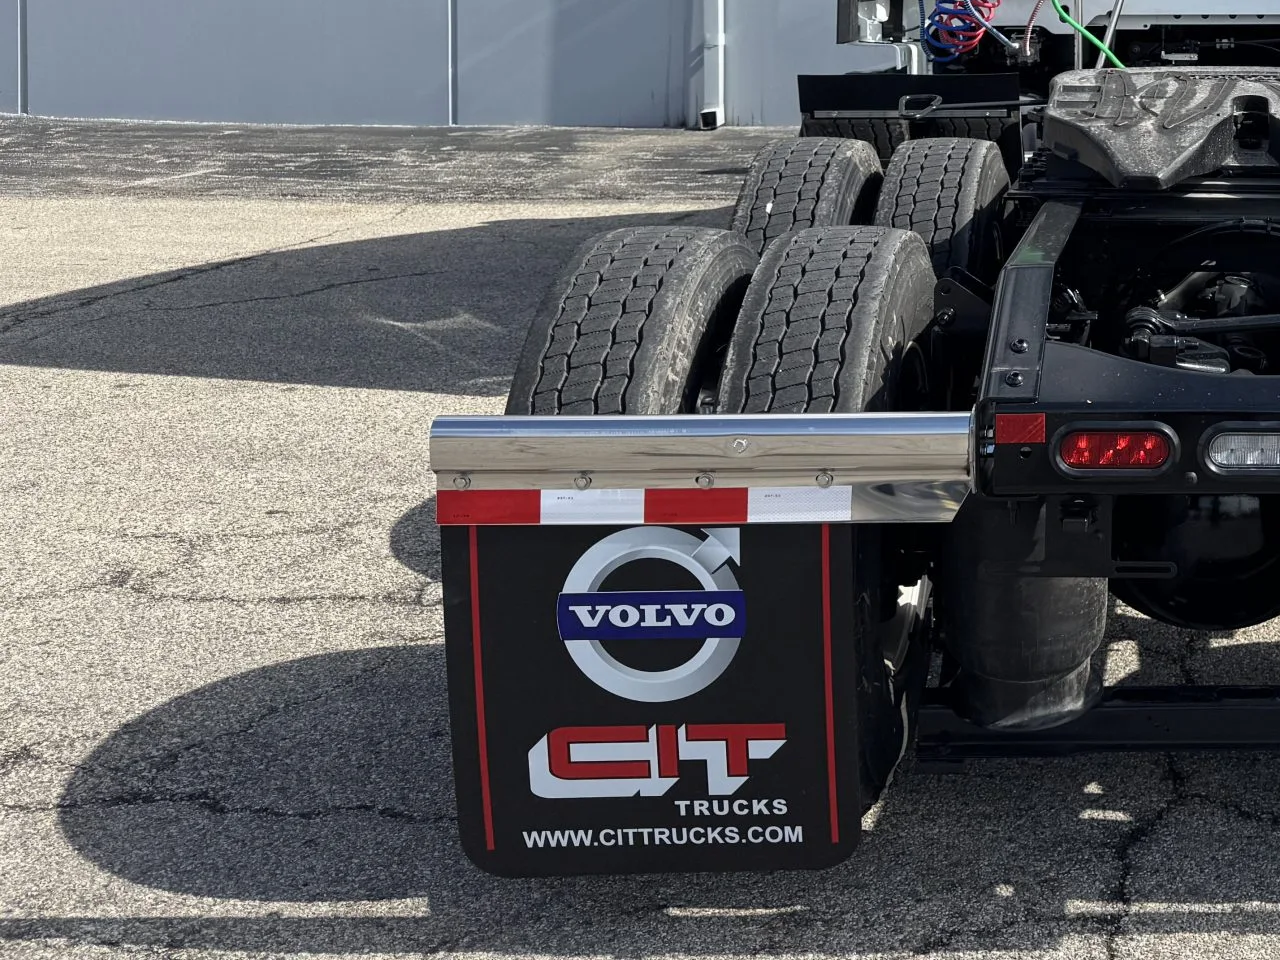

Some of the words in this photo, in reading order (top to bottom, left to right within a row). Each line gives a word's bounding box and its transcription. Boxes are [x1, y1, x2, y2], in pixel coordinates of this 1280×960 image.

[568, 603, 736, 628] VOLVO
[527, 722, 788, 799] CIT
[674, 798, 788, 816] TRUCKS
[522, 825, 803, 848] WWW.CITTRUCKS.COM
